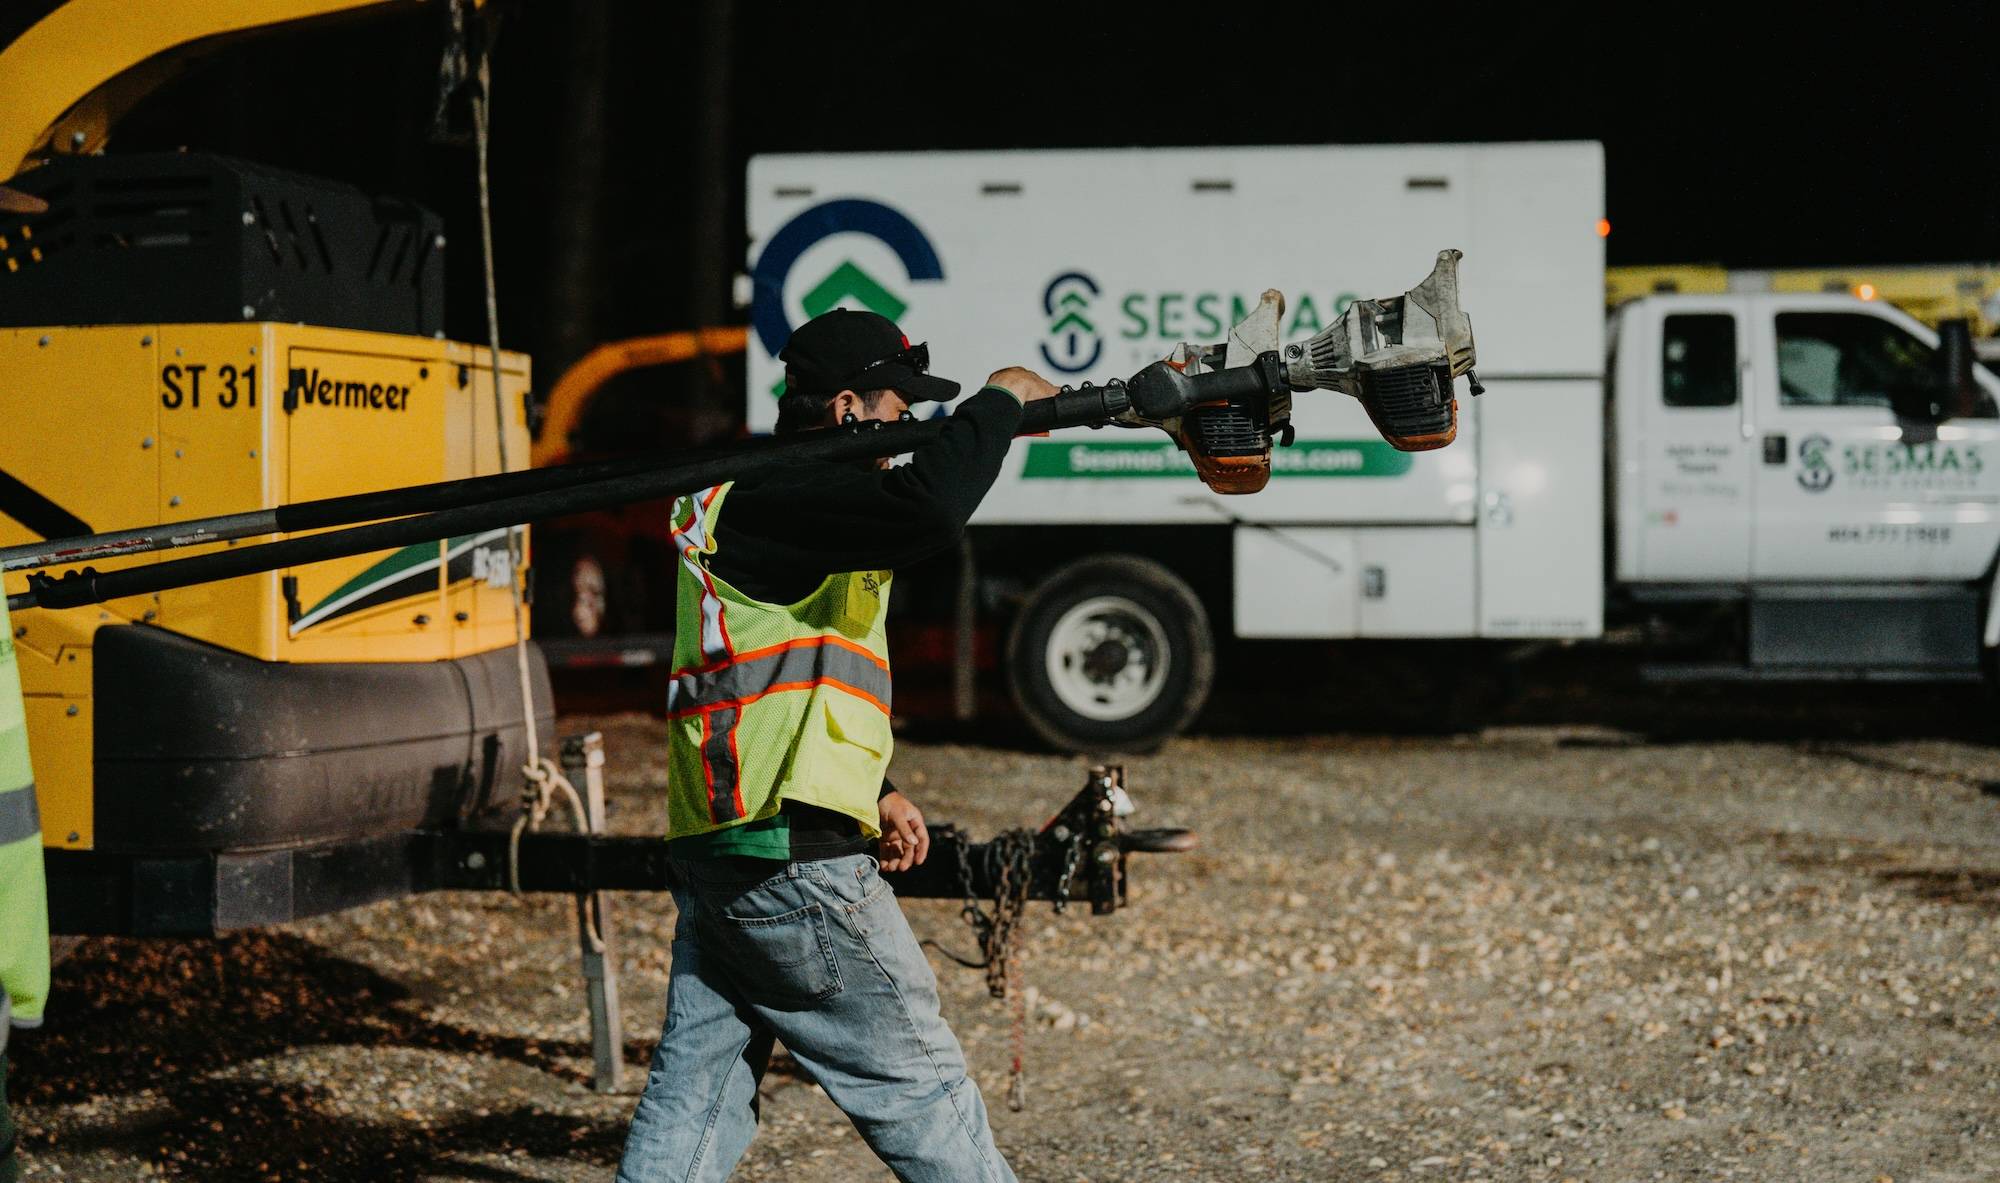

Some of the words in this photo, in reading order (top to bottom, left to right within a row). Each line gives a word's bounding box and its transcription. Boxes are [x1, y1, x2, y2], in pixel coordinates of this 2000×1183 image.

[160, 363, 206, 409] ST
[218, 364, 256, 408] 31
[299, 368, 409, 411] Vermeer
[1844, 444, 1984, 472] SESMAS
